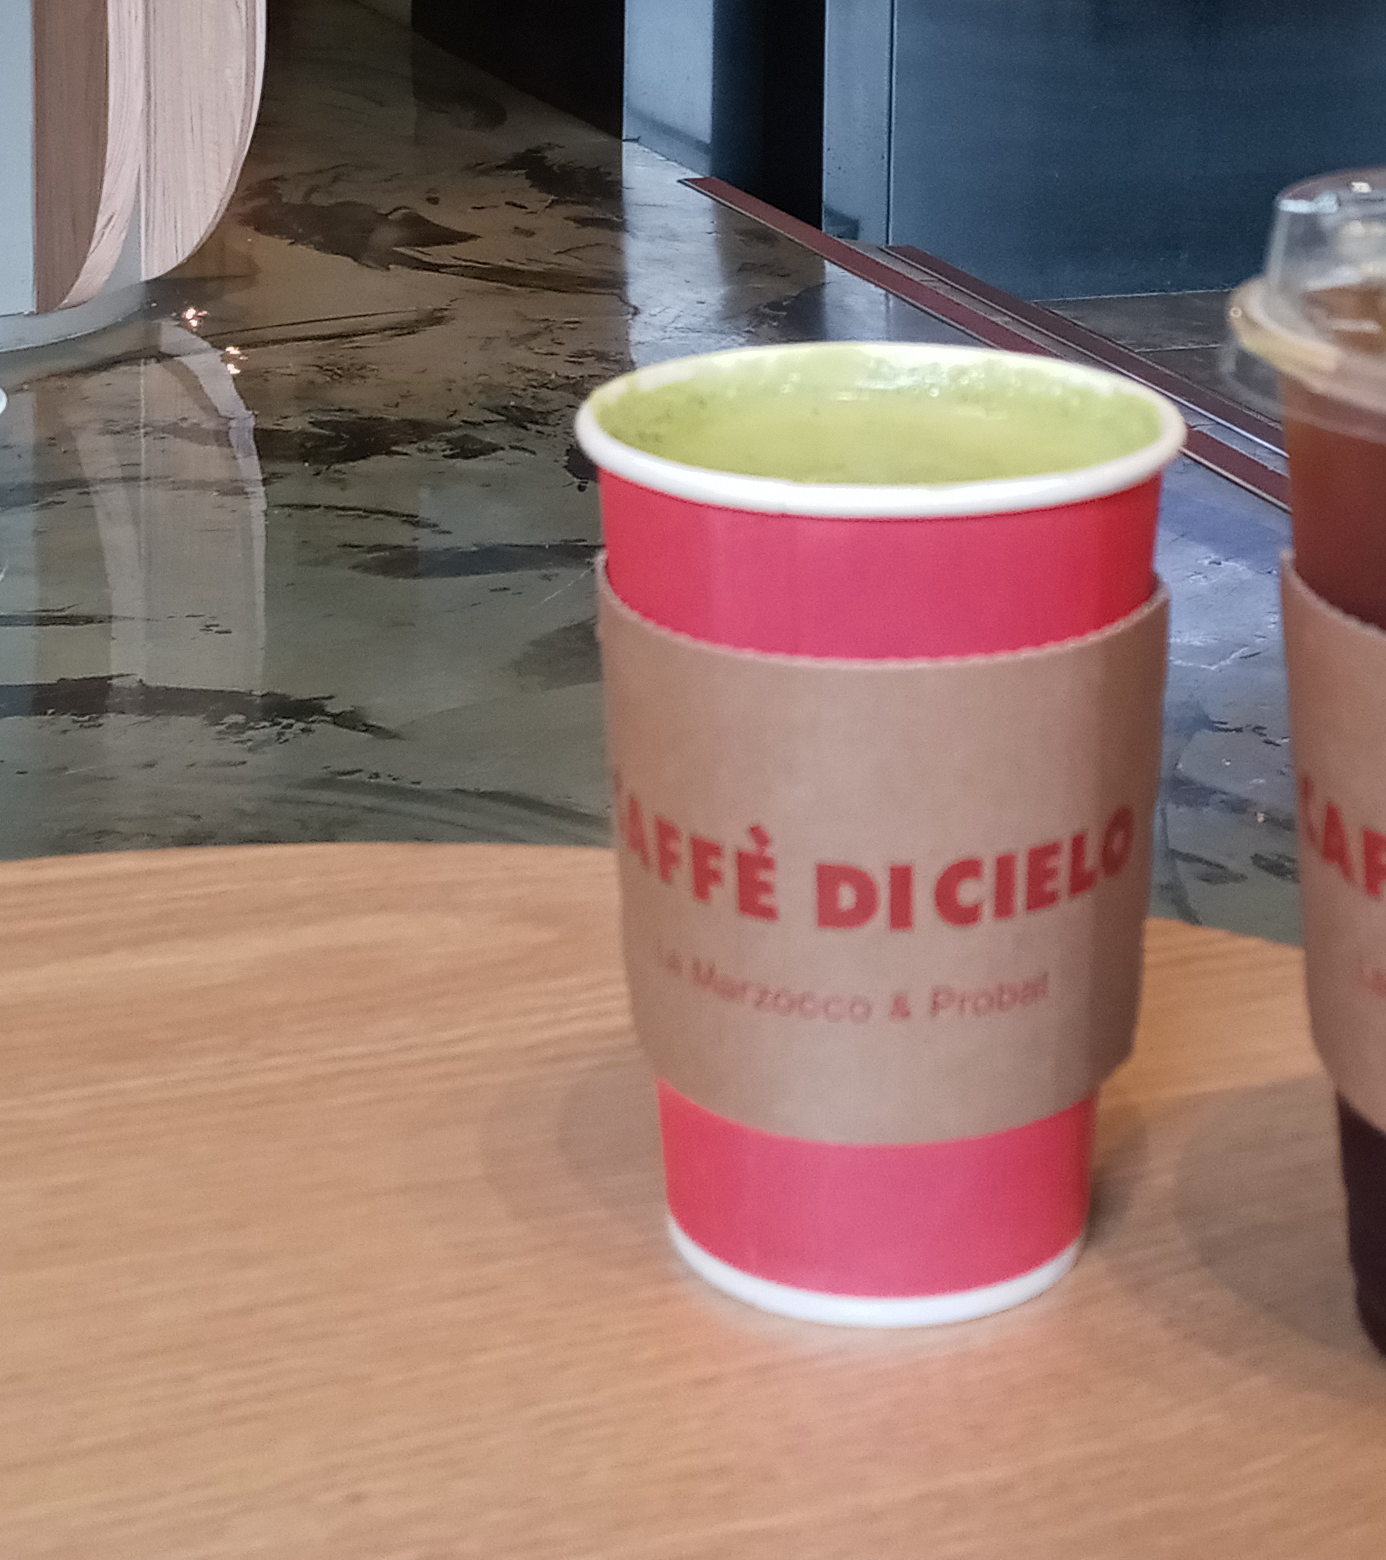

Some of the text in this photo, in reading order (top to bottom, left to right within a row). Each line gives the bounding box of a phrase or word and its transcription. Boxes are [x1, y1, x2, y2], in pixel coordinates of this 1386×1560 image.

[614, 770, 1134, 930] AFFÈ DI CIELO
[690, 956, 872, 1023] Marzocco
[890, 994, 911, 1020] &
